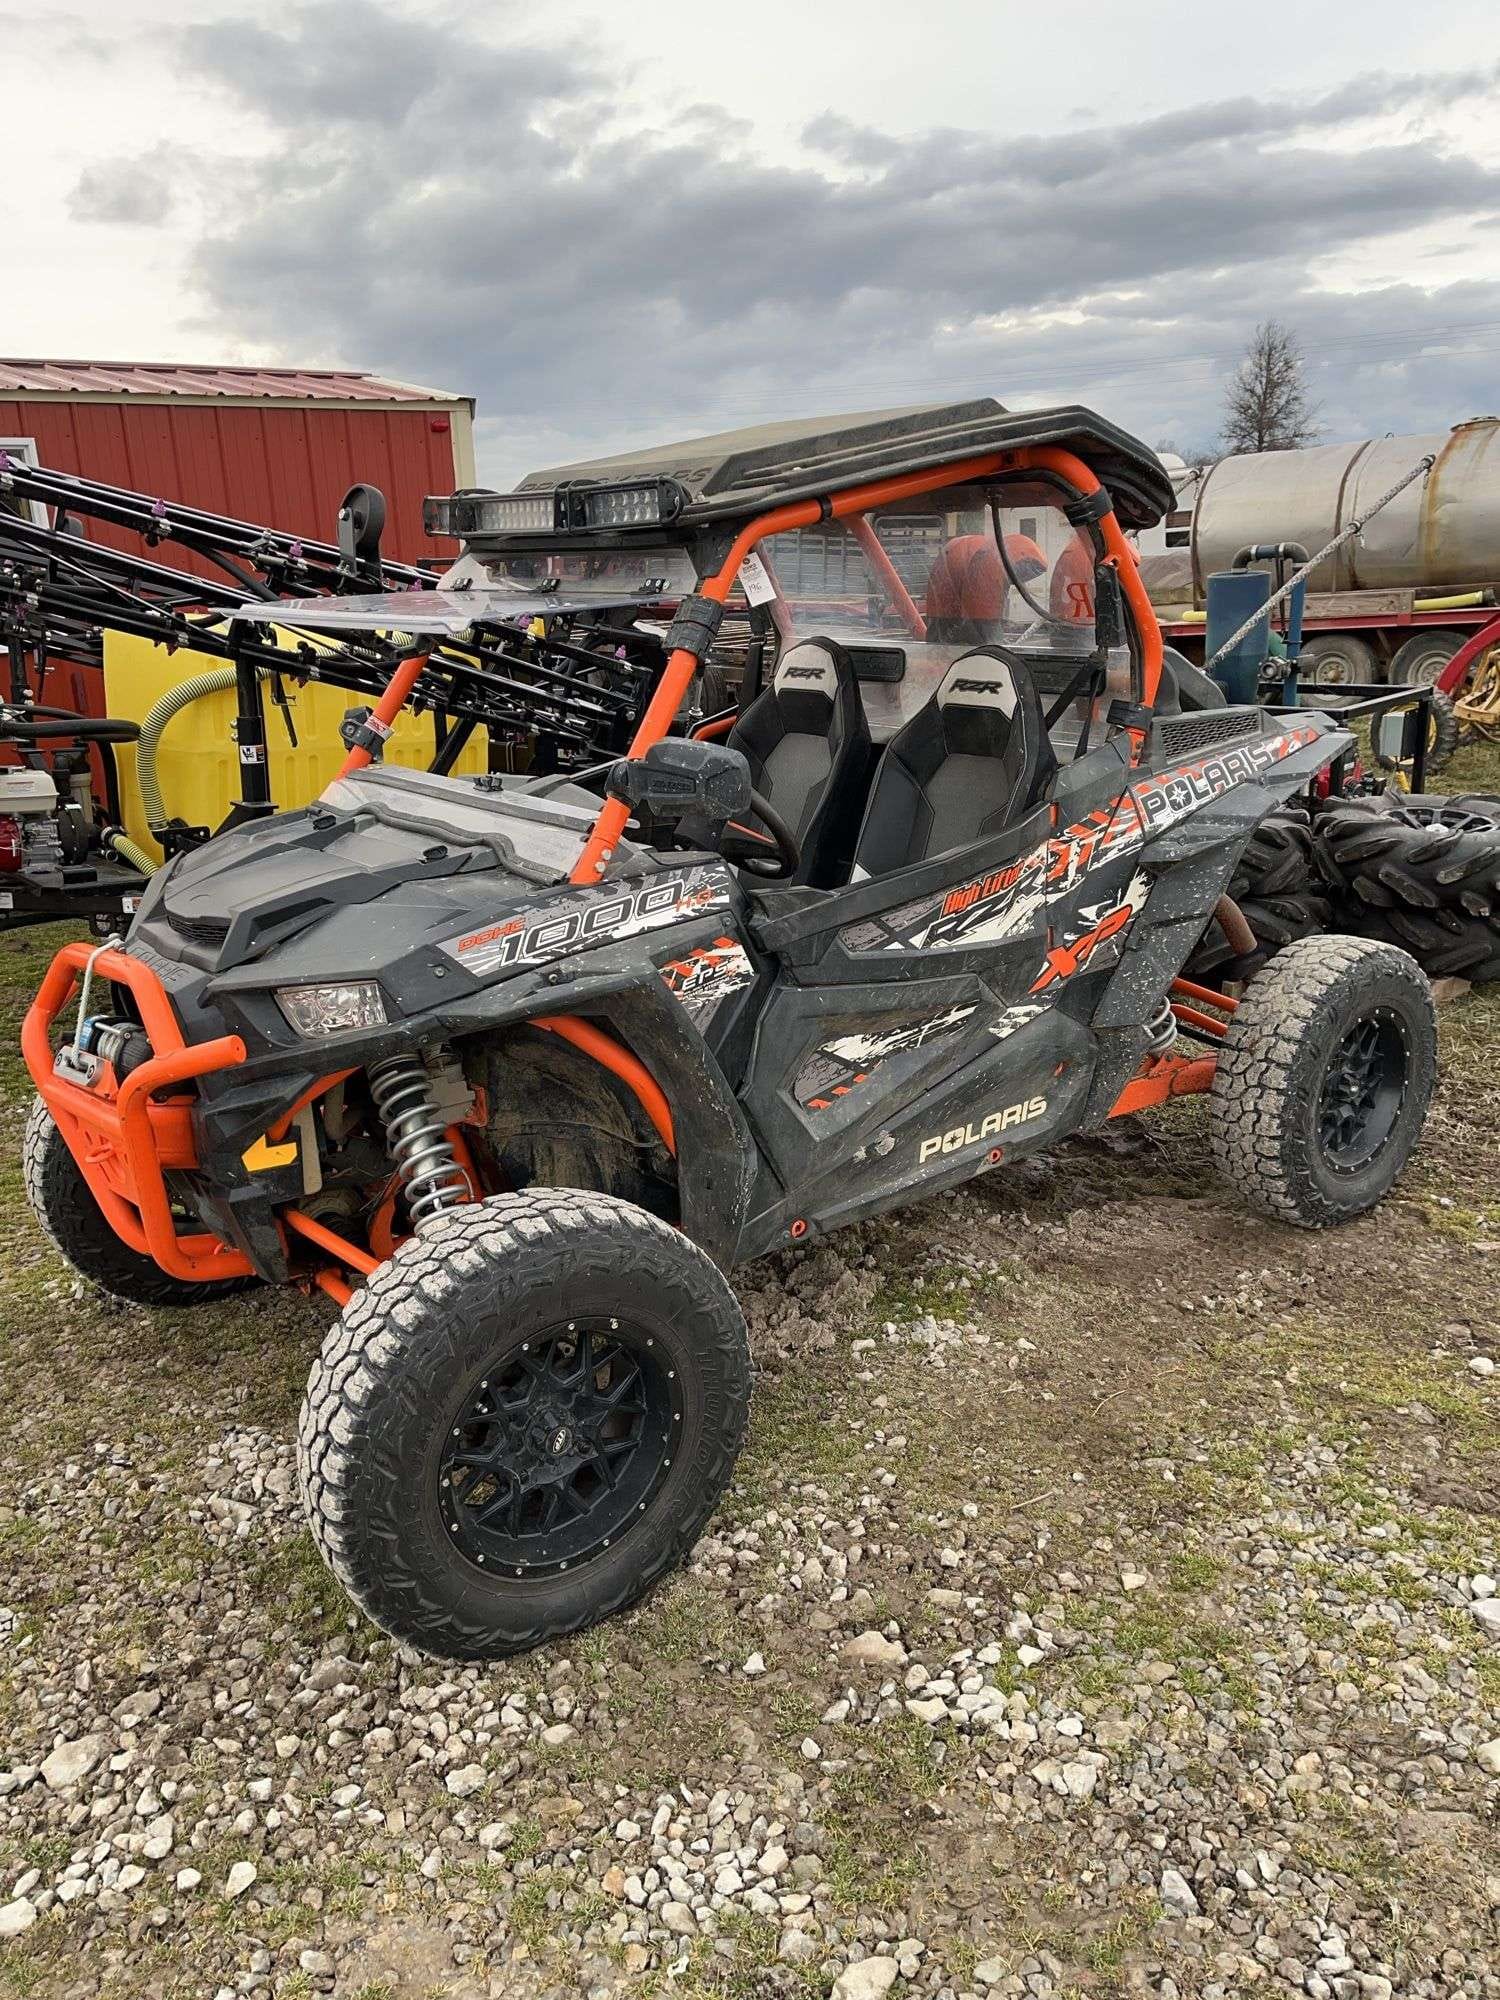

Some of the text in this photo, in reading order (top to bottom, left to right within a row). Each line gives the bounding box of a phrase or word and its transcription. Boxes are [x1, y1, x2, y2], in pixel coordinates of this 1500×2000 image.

[782, 666, 826, 681] RZR
[948, 677, 1004, 696] RZR
[1137, 744, 1275, 827] POLARIS
[941, 882, 982, 917] High
[458, 915, 527, 952] DOHC
[499, 878, 685, 968] 1000
[681, 959, 728, 993] EPS
[918, 1095, 1048, 1164] POLARIS
